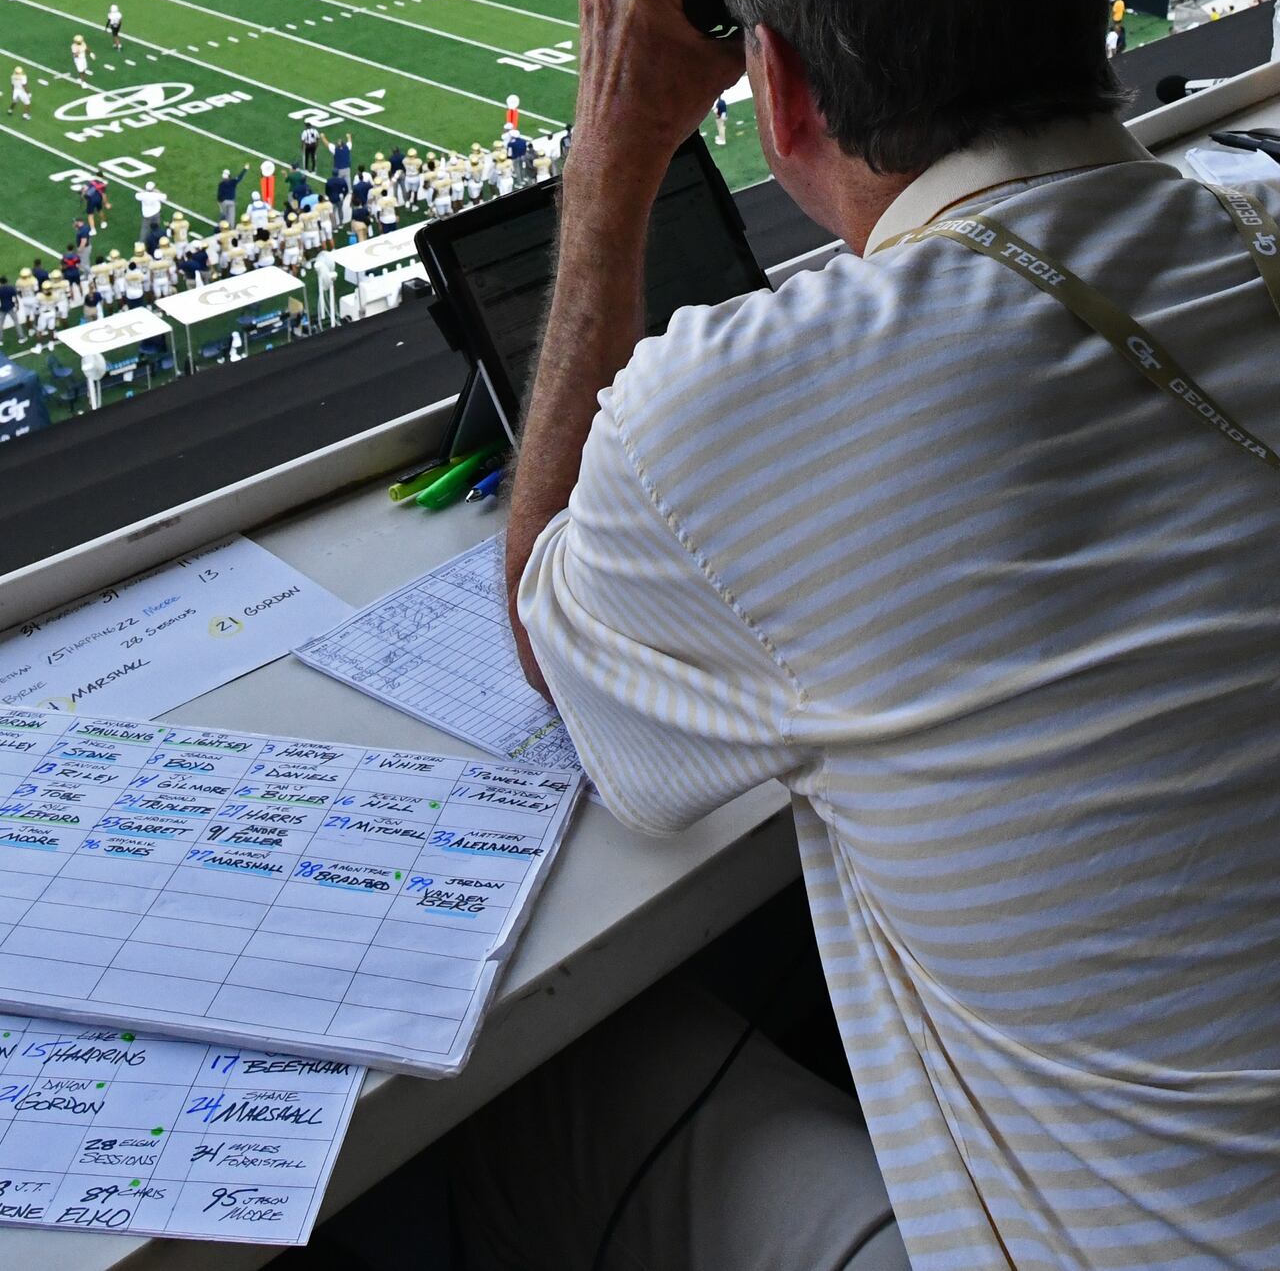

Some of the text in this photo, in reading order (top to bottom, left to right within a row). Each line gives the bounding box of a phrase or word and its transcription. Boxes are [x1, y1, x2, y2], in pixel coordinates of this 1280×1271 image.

[496, 47, 577, 72] 10
[65, 90, 254, 143] HYUNDAI
[287, 96, 387, 128] 20
[49, 155, 157, 191] 30
[1000, 241, 1067, 288] TECH
[1169, 378, 1269, 460] GEORGIA
[242, 585, 301, 618] GORDON
[71, 657, 152, 704] MARSHALL
[77, 723, 155, 743] SPAULDING
[179, 737, 254, 753] LIGHTSEY
[62, 747, 122, 762] STONE
[275, 747, 345, 765] HARVEY
[163, 757, 216, 773] BOYD
[378, 758, 436, 773] WHITE
[56, 768, 120, 784] RILEY
[265, 767, 339, 784] DANIELS
[39, 787, 87, 803] TOBE
[156, 780, 231, 796] GILMORE
[260, 789, 330, 805] BUTLER
[468, 791, 558, 814] MANLEY
[139, 799, 216, 815] TRIPLETTE
[359, 799, 415, 814] HILL
[238, 810, 308, 826] HARRIS
[118, 821, 194, 836] GARRETT
[346, 820, 427, 841] MITCHELL
[0, 832, 60, 847] MOORE
[225, 831, 284, 848] FULLER
[448, 838, 545, 858] ALEXANDER
[104, 844, 155, 858] JONES
[204, 856, 285, 874] MARSHALL
[313, 871, 391, 892] BRADFORD
[444, 878, 506, 890] JORDAN
[416, 897, 486, 914] BERG
[42, 1044, 146, 1066] HARPRING
[211, 1055, 241, 1074] 17
[14, 1091, 105, 1115] GORDON
[242, 1091, 301, 1102] SHANE
[186, 1093, 323, 1125] 24 MARSHALL
[83, 1138, 118, 1151] 28
[79, 1151, 158, 1167] SESSIONS
[217, 1154, 307, 1170] FORRISTALL
[80, 1184, 119, 1204] 89
[203, 1188, 289, 1213] 95 JASON
[55, 1206, 131, 1228] ELKO
[218, 1206, 284, 1222] MOORE
